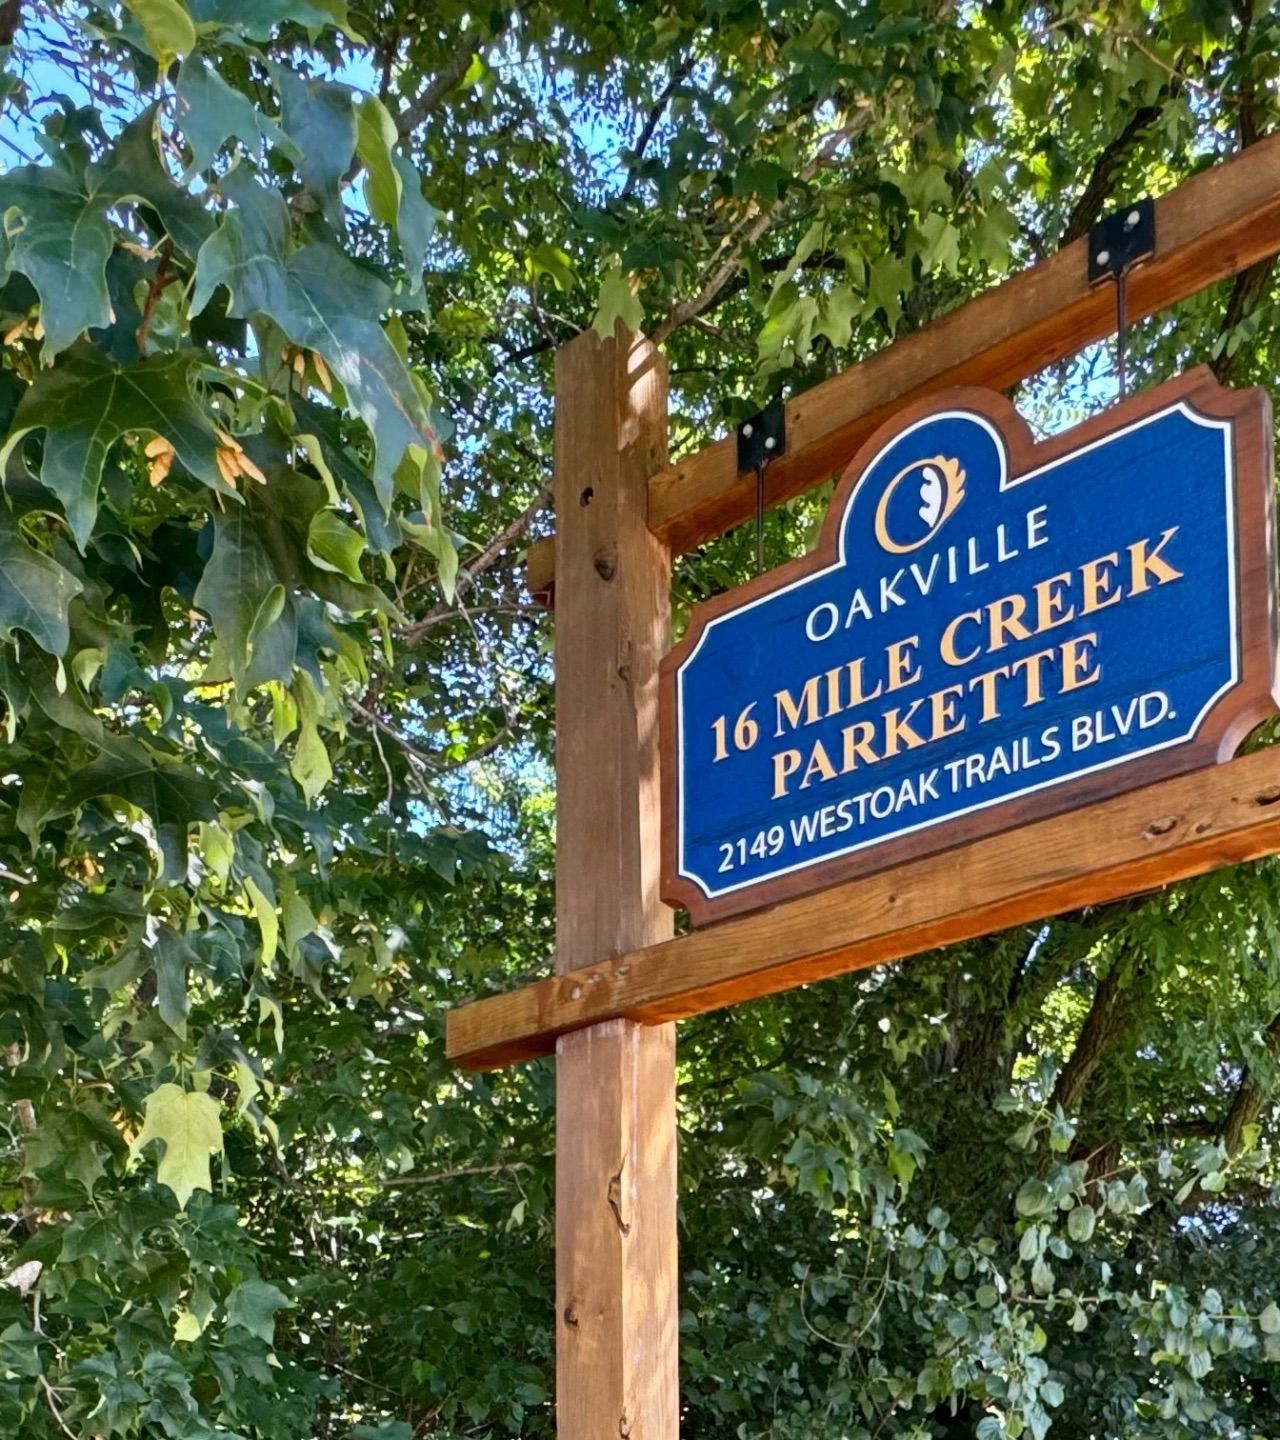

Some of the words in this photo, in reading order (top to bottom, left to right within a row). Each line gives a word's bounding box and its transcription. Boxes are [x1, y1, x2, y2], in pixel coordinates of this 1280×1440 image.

[711, 702, 759, 762] 16
[774, 635, 922, 737] MILE
[940, 526, 1184, 666] CREEK
[805, 505, 1049, 642] OAKVILLE
[718, 825, 785, 873] 2149
[791, 768, 940, 847] WESTOAK
[944, 726, 1061, 793] TRAILS
[1072, 691, 1177, 752] BLVD.
[771, 632, 1101, 800] PARKETTE
